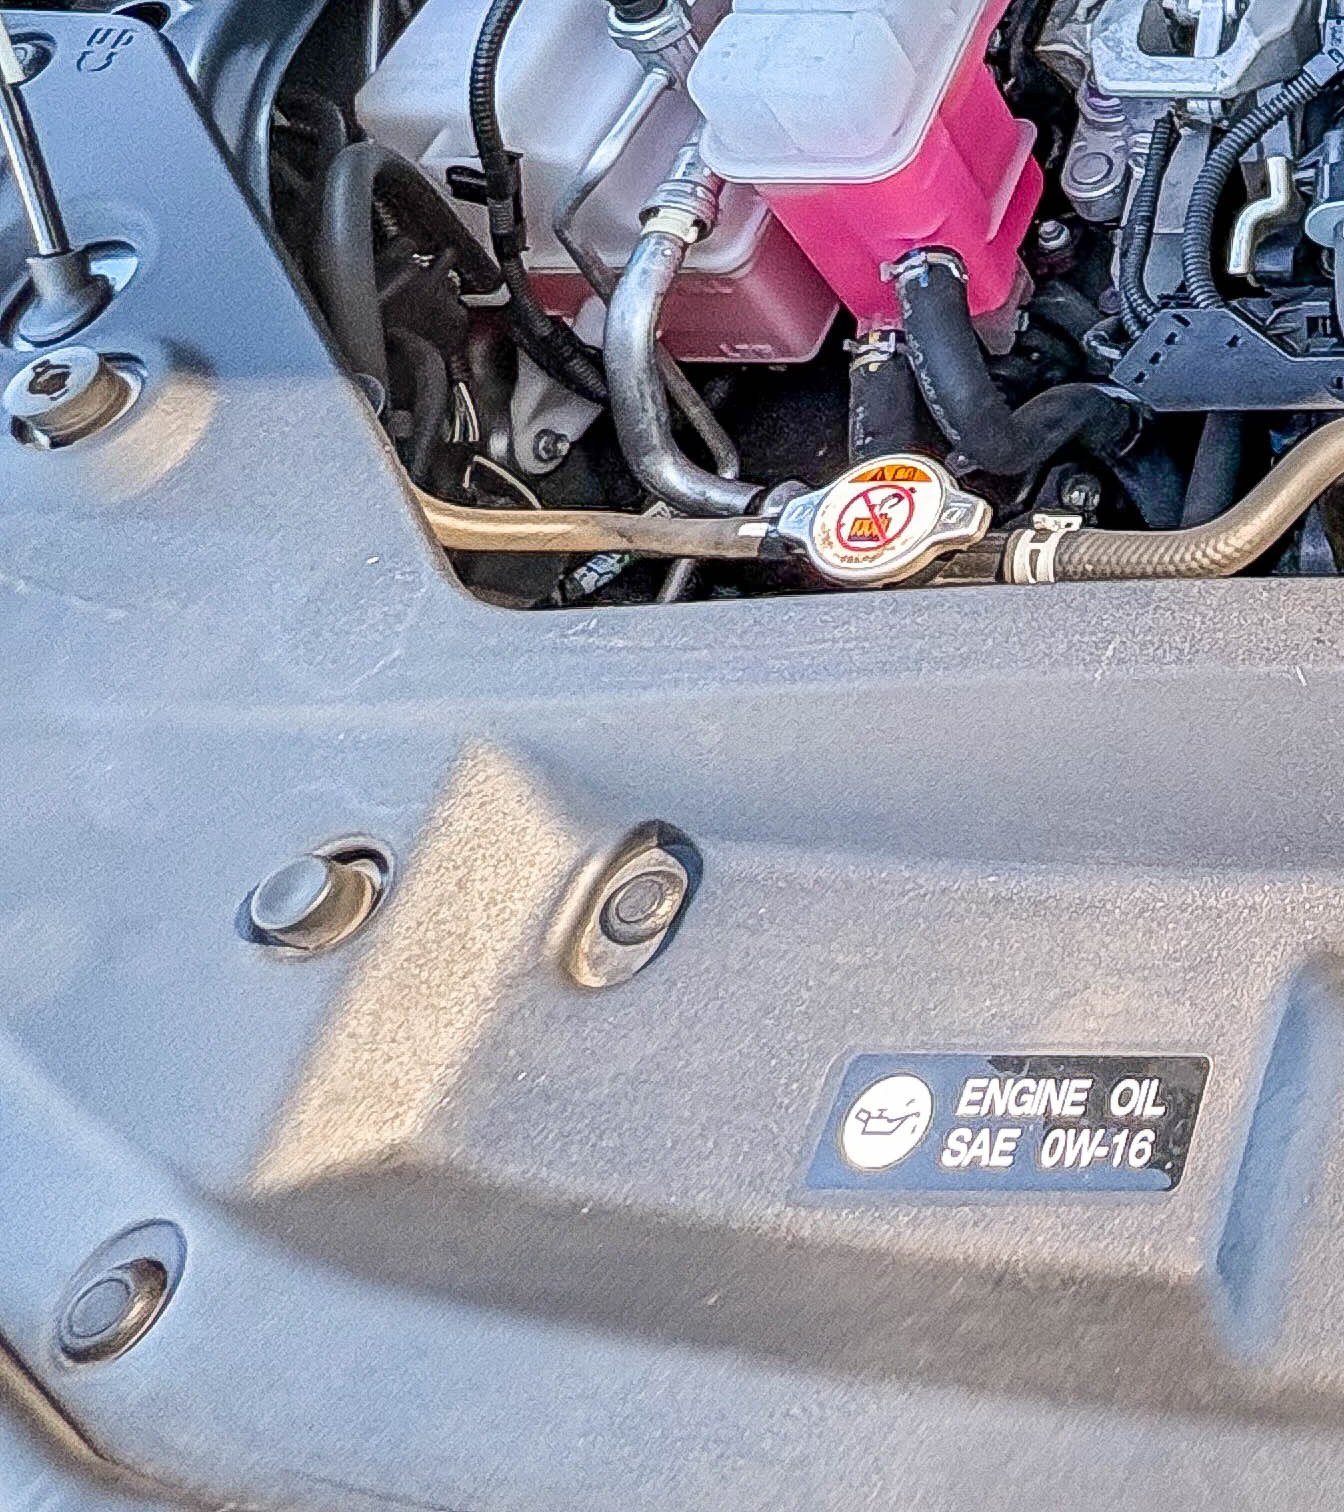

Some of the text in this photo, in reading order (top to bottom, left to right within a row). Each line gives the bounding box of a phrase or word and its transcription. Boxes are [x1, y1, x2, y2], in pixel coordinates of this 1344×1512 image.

[955, 1078, 1167, 1117] ENGINE OIL
[940, 1128, 1156, 1168] SAE 0W-16
